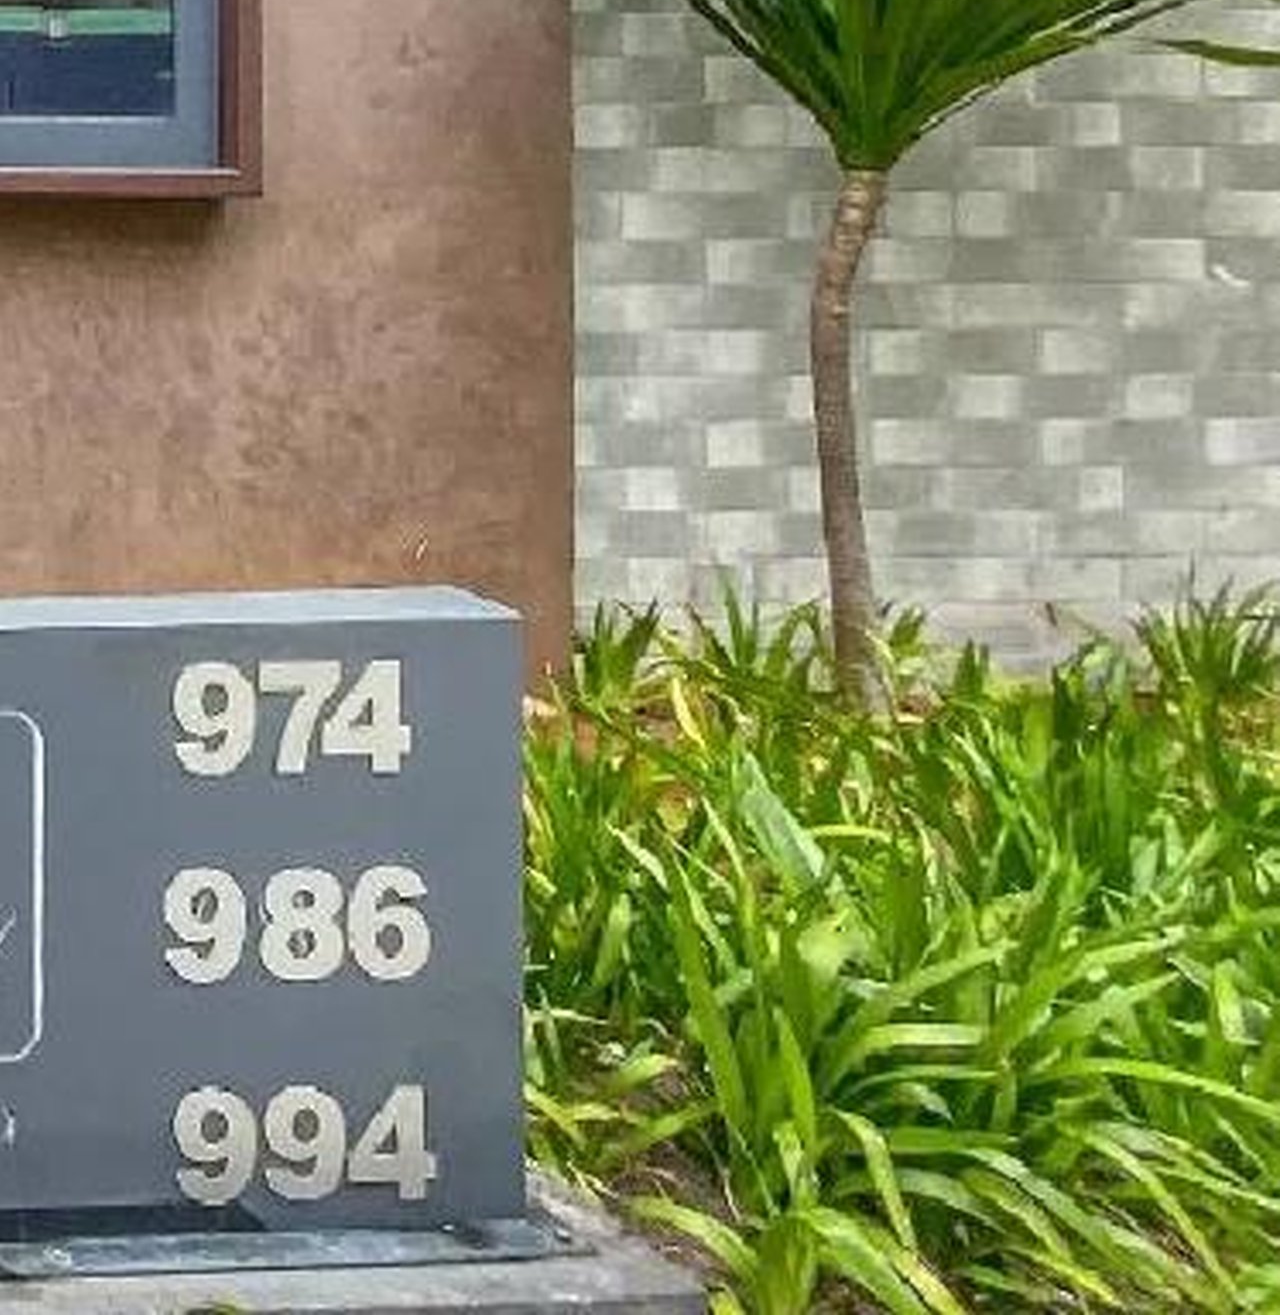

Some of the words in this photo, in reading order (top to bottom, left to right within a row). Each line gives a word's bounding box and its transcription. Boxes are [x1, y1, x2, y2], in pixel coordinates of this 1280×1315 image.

[172, 659, 412, 776] 974
[163, 864, 432, 984] 986
[172, 1084, 437, 1206] 994
